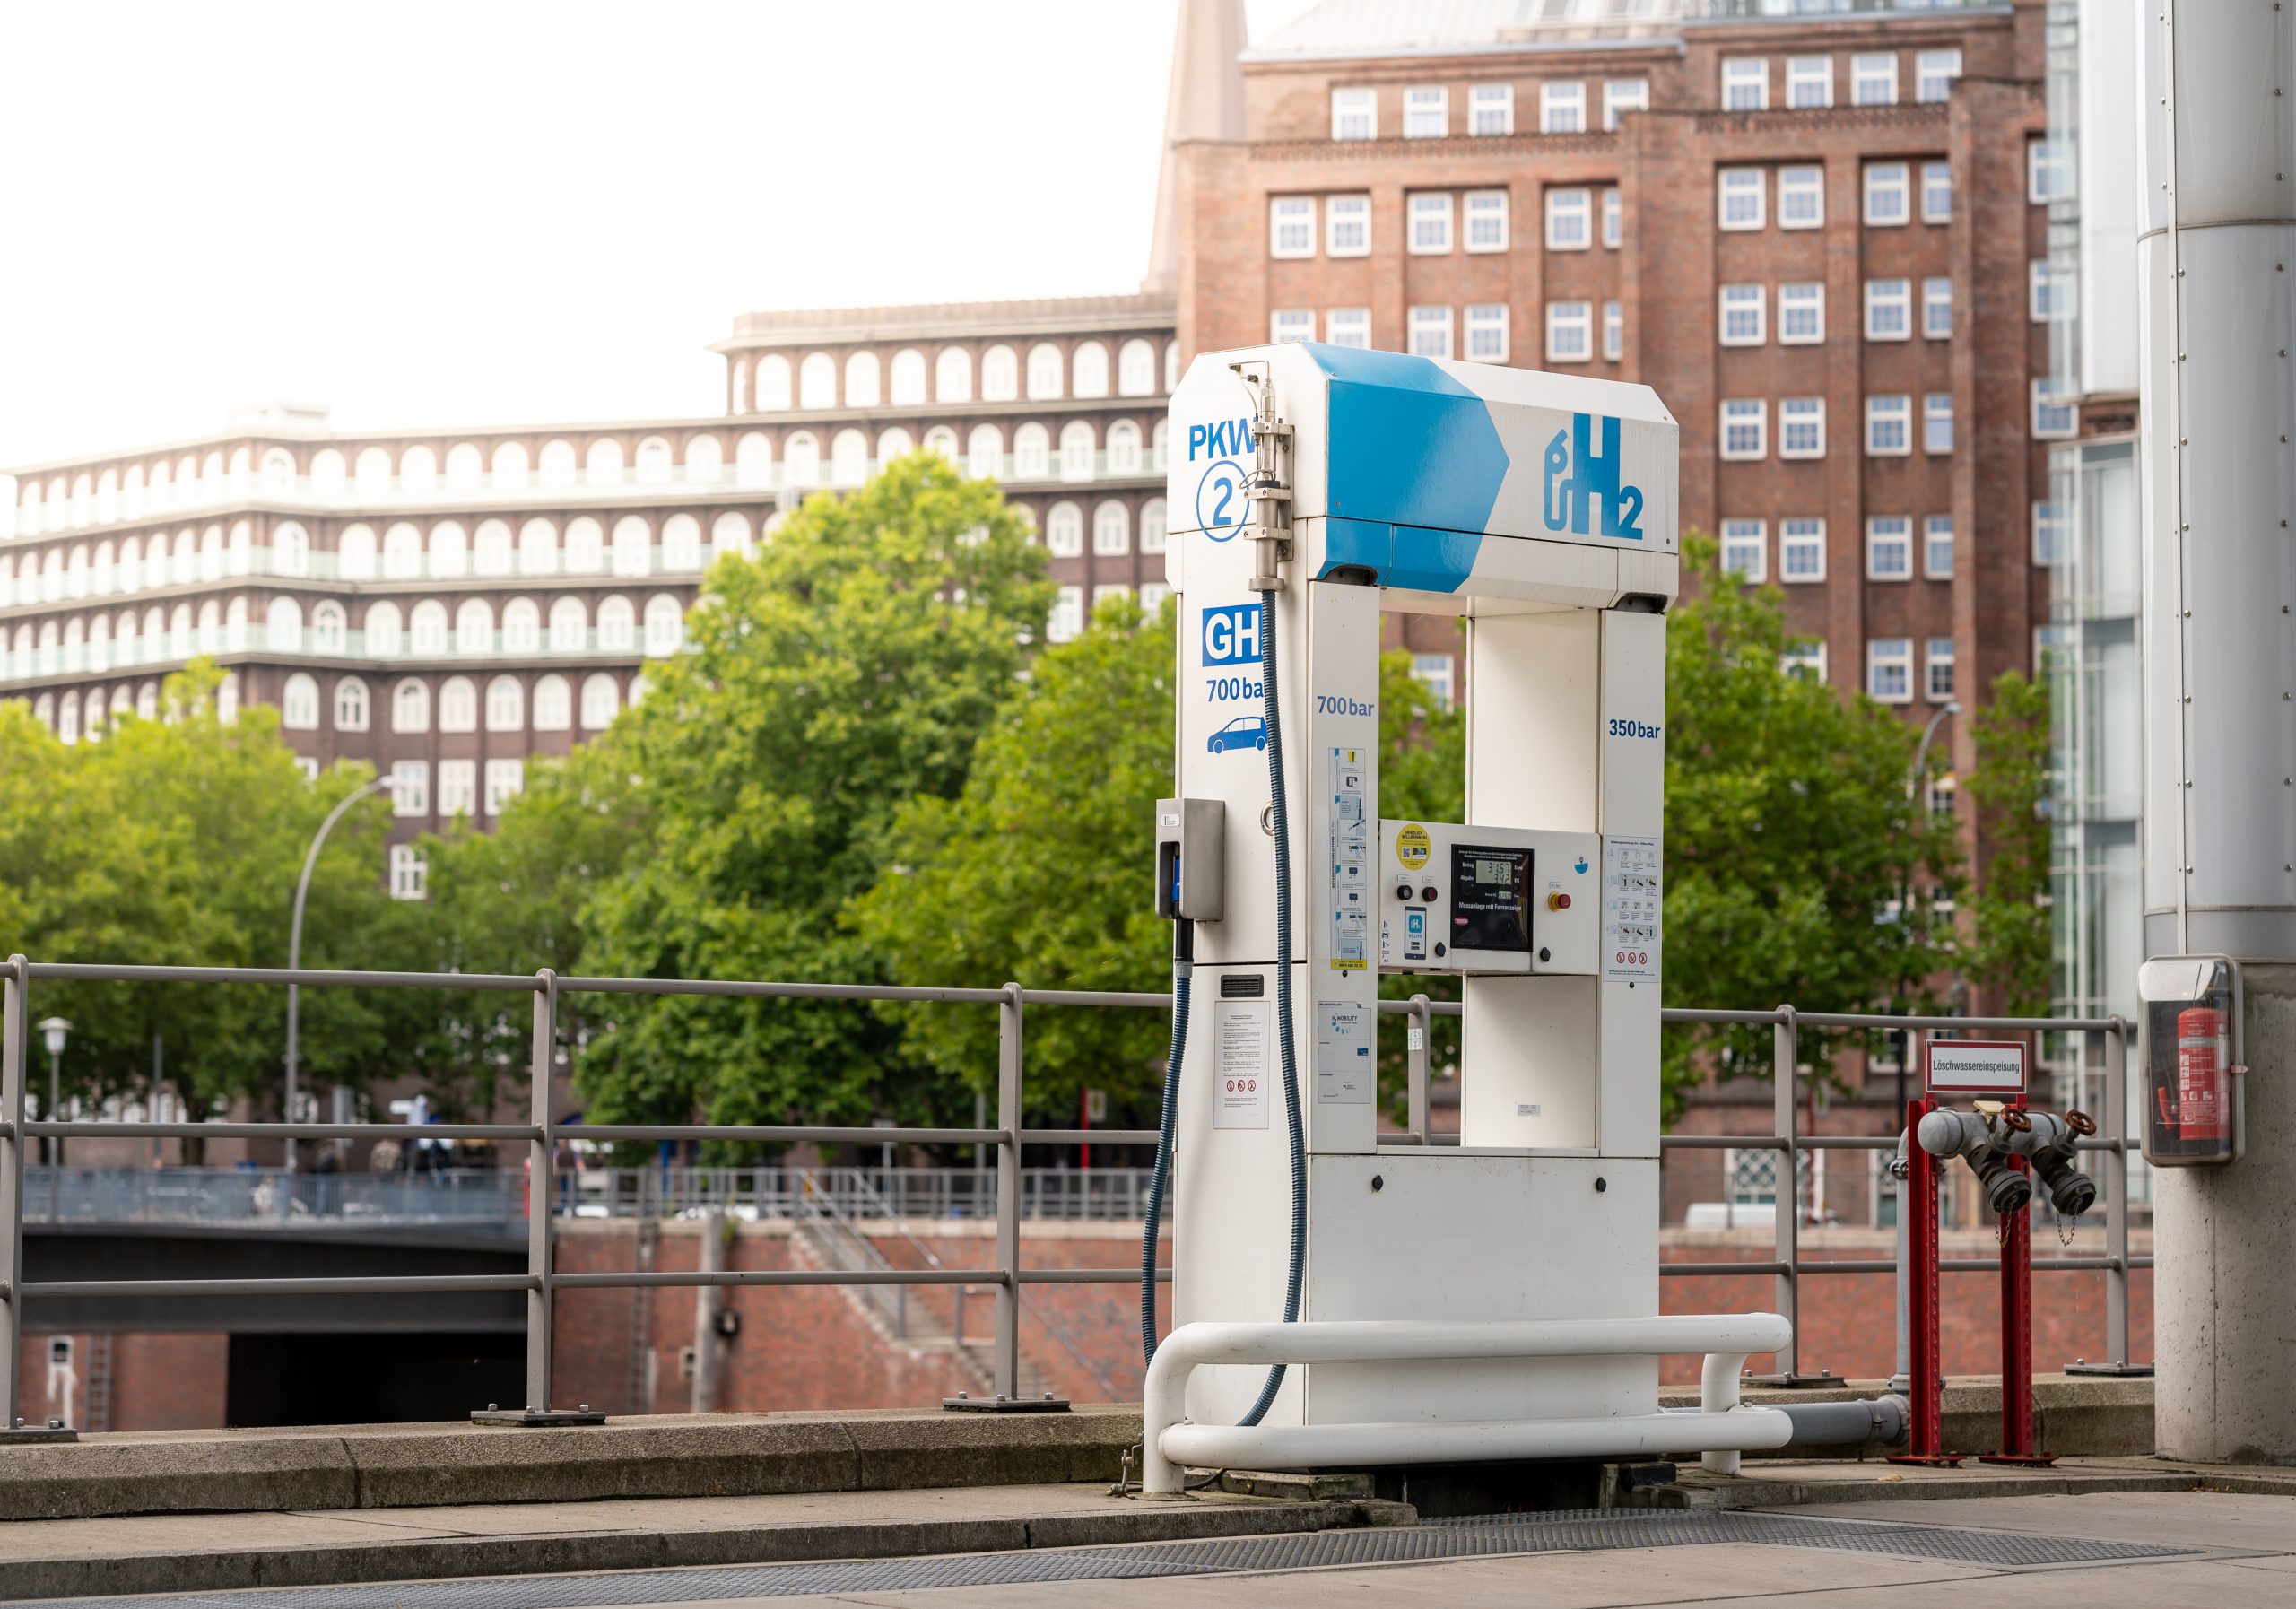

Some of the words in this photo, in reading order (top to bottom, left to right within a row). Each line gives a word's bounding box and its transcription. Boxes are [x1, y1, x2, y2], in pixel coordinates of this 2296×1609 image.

[1189, 417, 1257, 461] PKW
[1213, 477, 1232, 526] 2
[1205, 610, 1264, 660] GH
[1458, 902, 1485, 910] Messanlage
[1933, 1059, 2020, 1074] Löschwassereinspeisung
